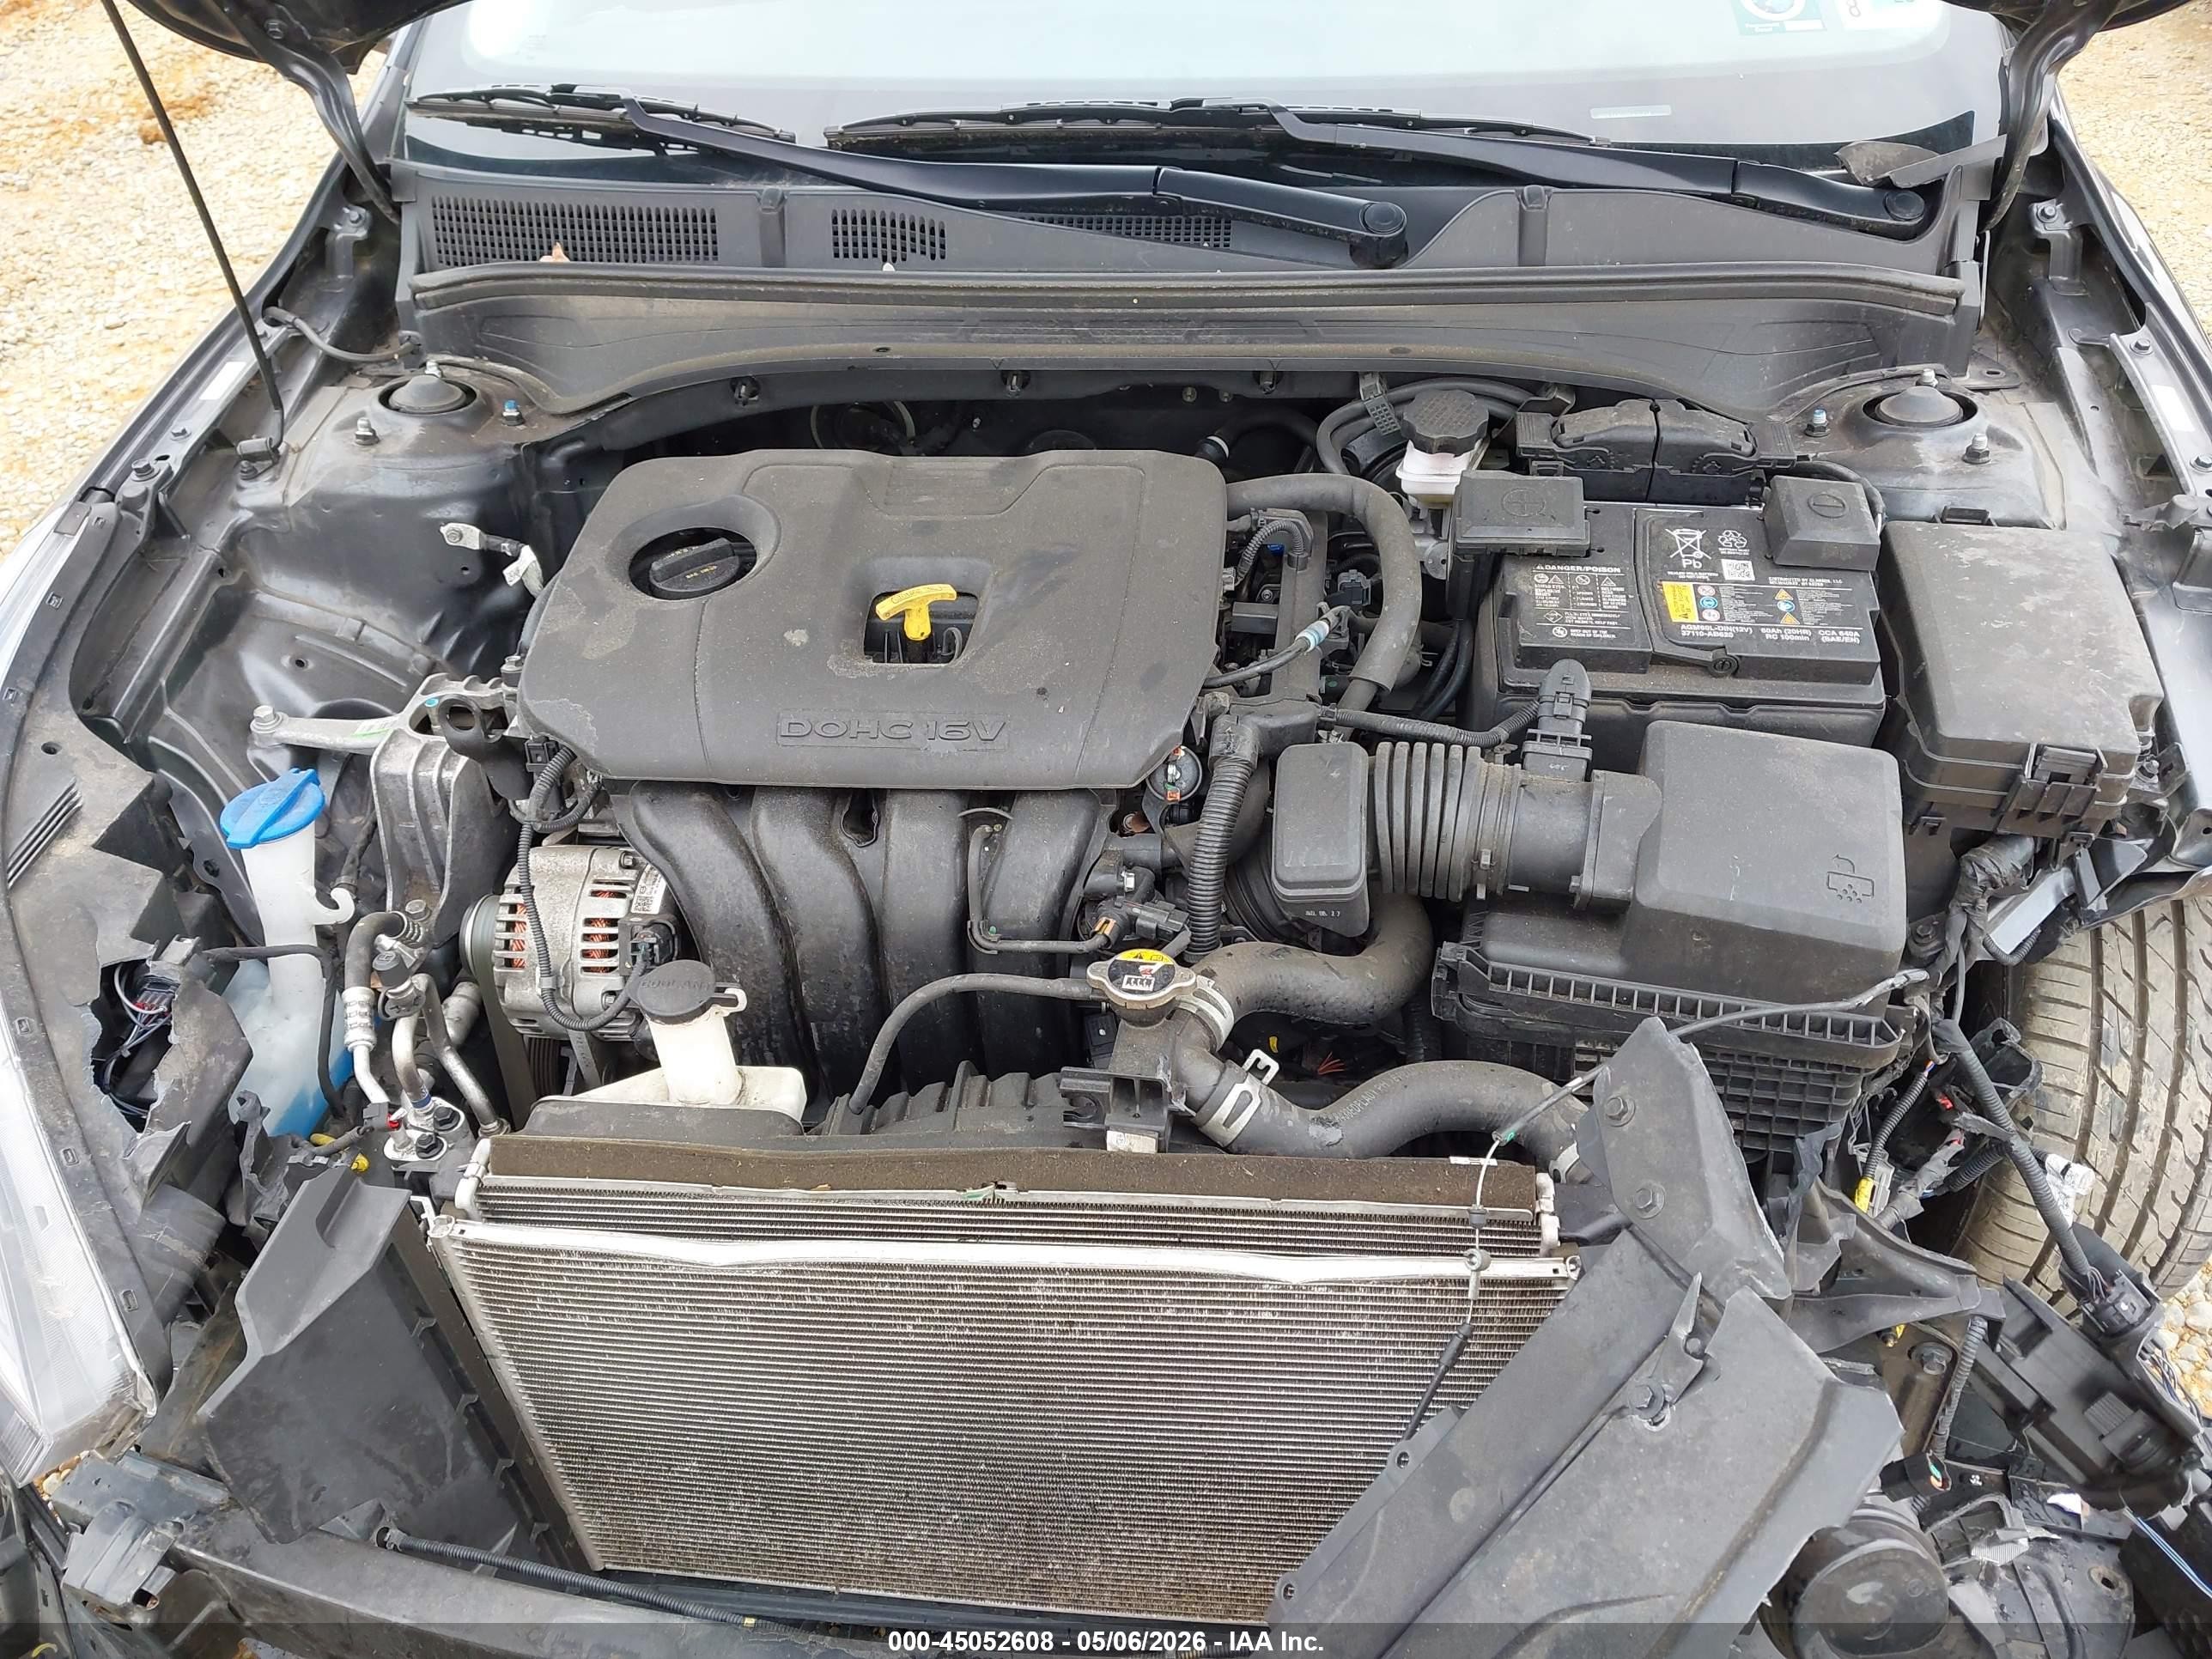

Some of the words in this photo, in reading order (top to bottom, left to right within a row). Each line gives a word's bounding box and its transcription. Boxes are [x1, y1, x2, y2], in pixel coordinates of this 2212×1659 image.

[1682, 558, 1702, 568] Pb
[1784, 628, 1812, 636] (20HR)
[779, 719, 914, 740] DOHC
[926, 720, 1006, 742] 16V
